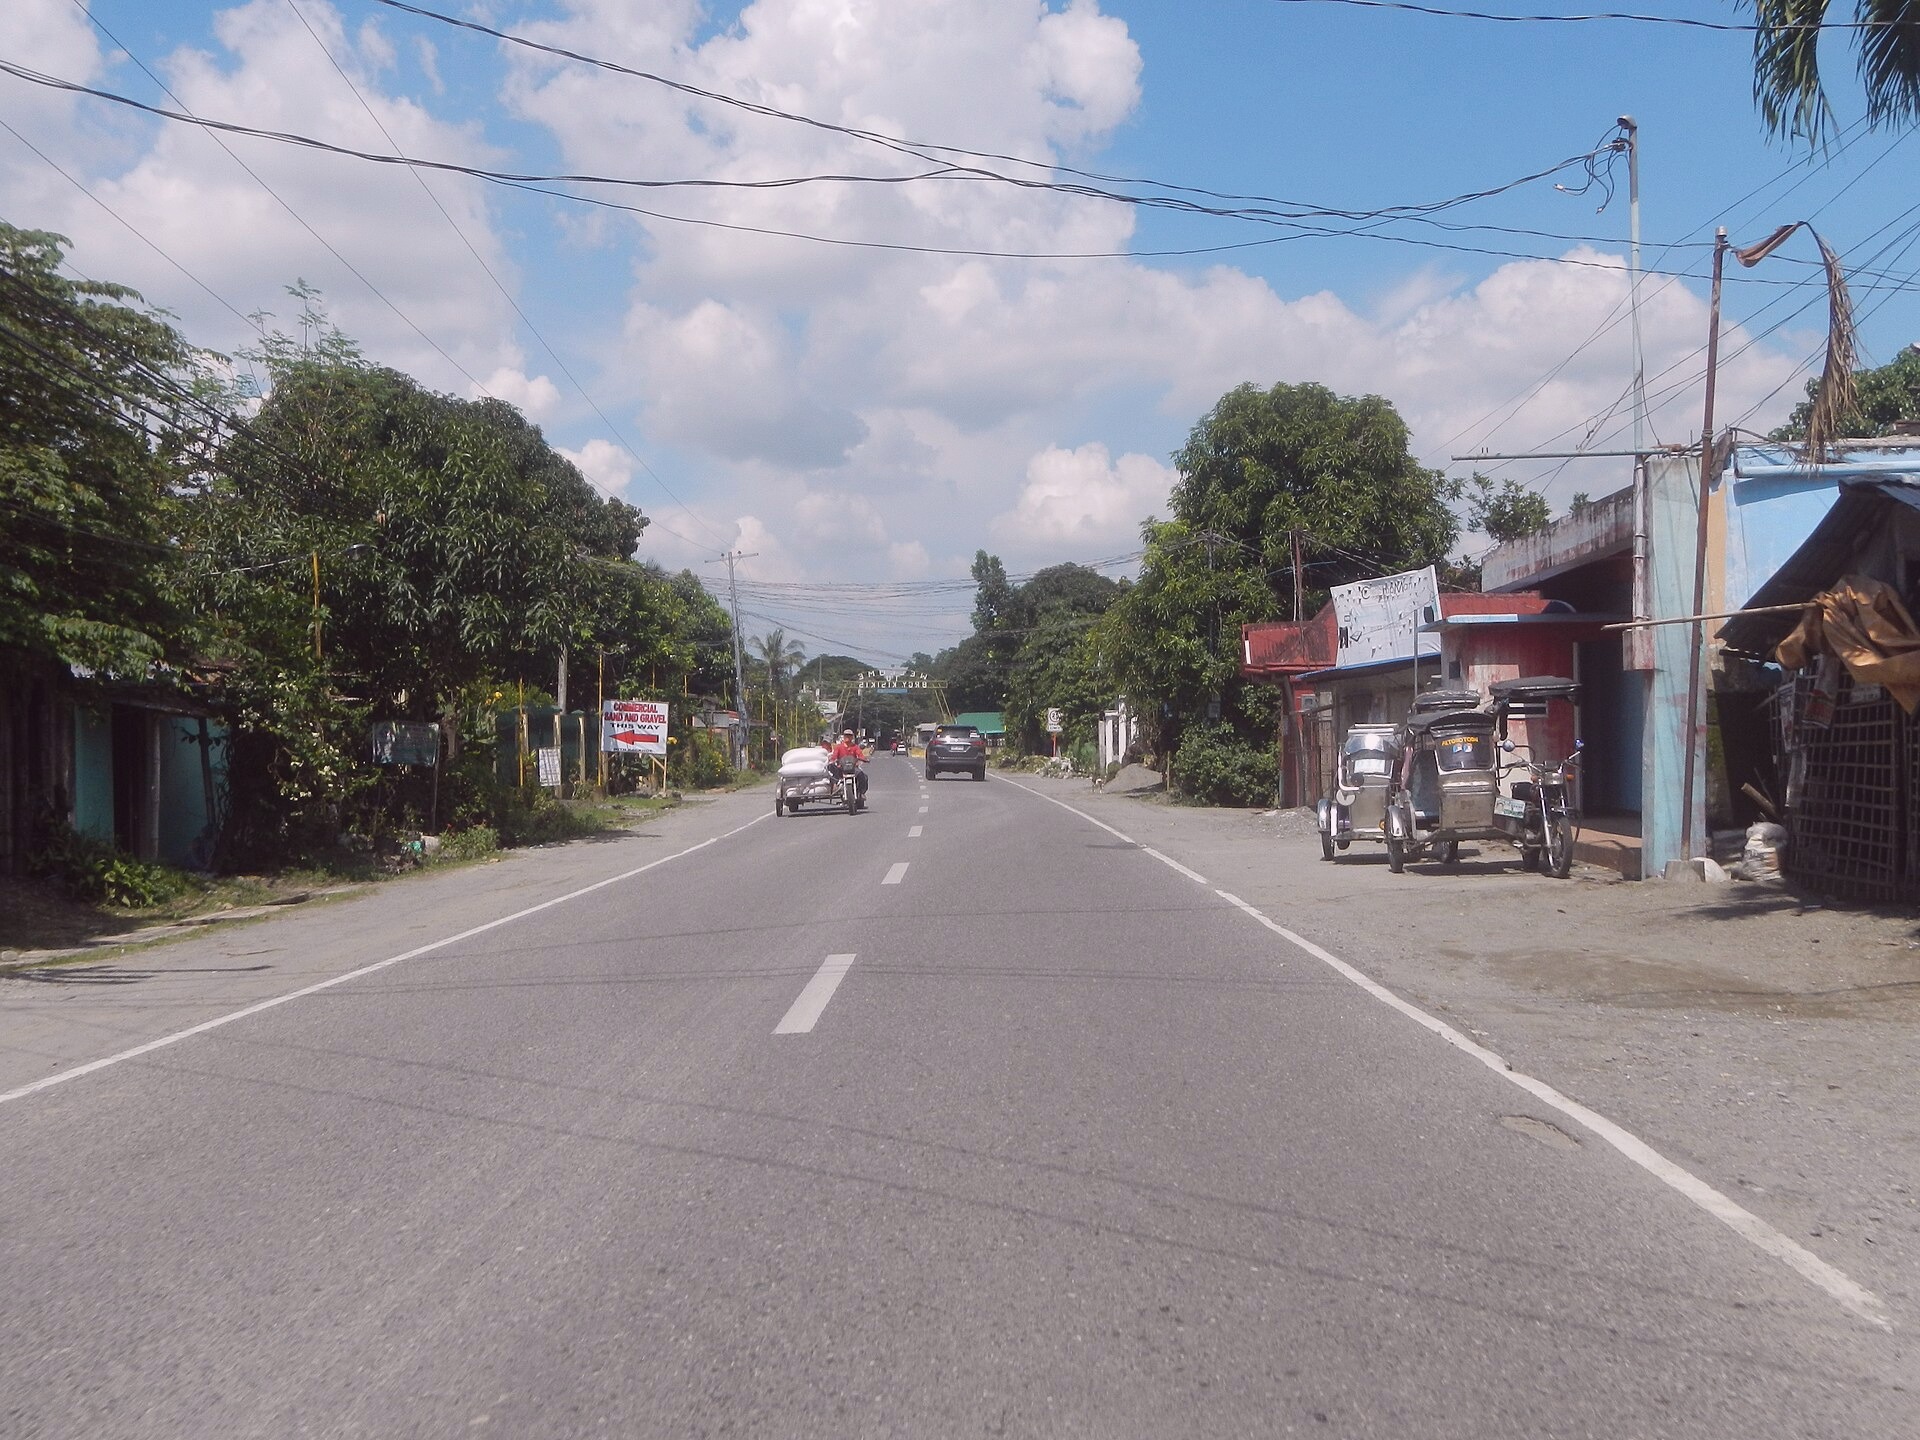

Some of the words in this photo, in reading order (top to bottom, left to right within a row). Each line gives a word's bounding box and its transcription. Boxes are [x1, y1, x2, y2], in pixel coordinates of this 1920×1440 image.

[614, 703, 658, 713] COMMERCIAL
[605, 712, 623, 721] SAND
[624, 712, 639, 722] AND
[640, 714, 666, 723] GRAVEL
